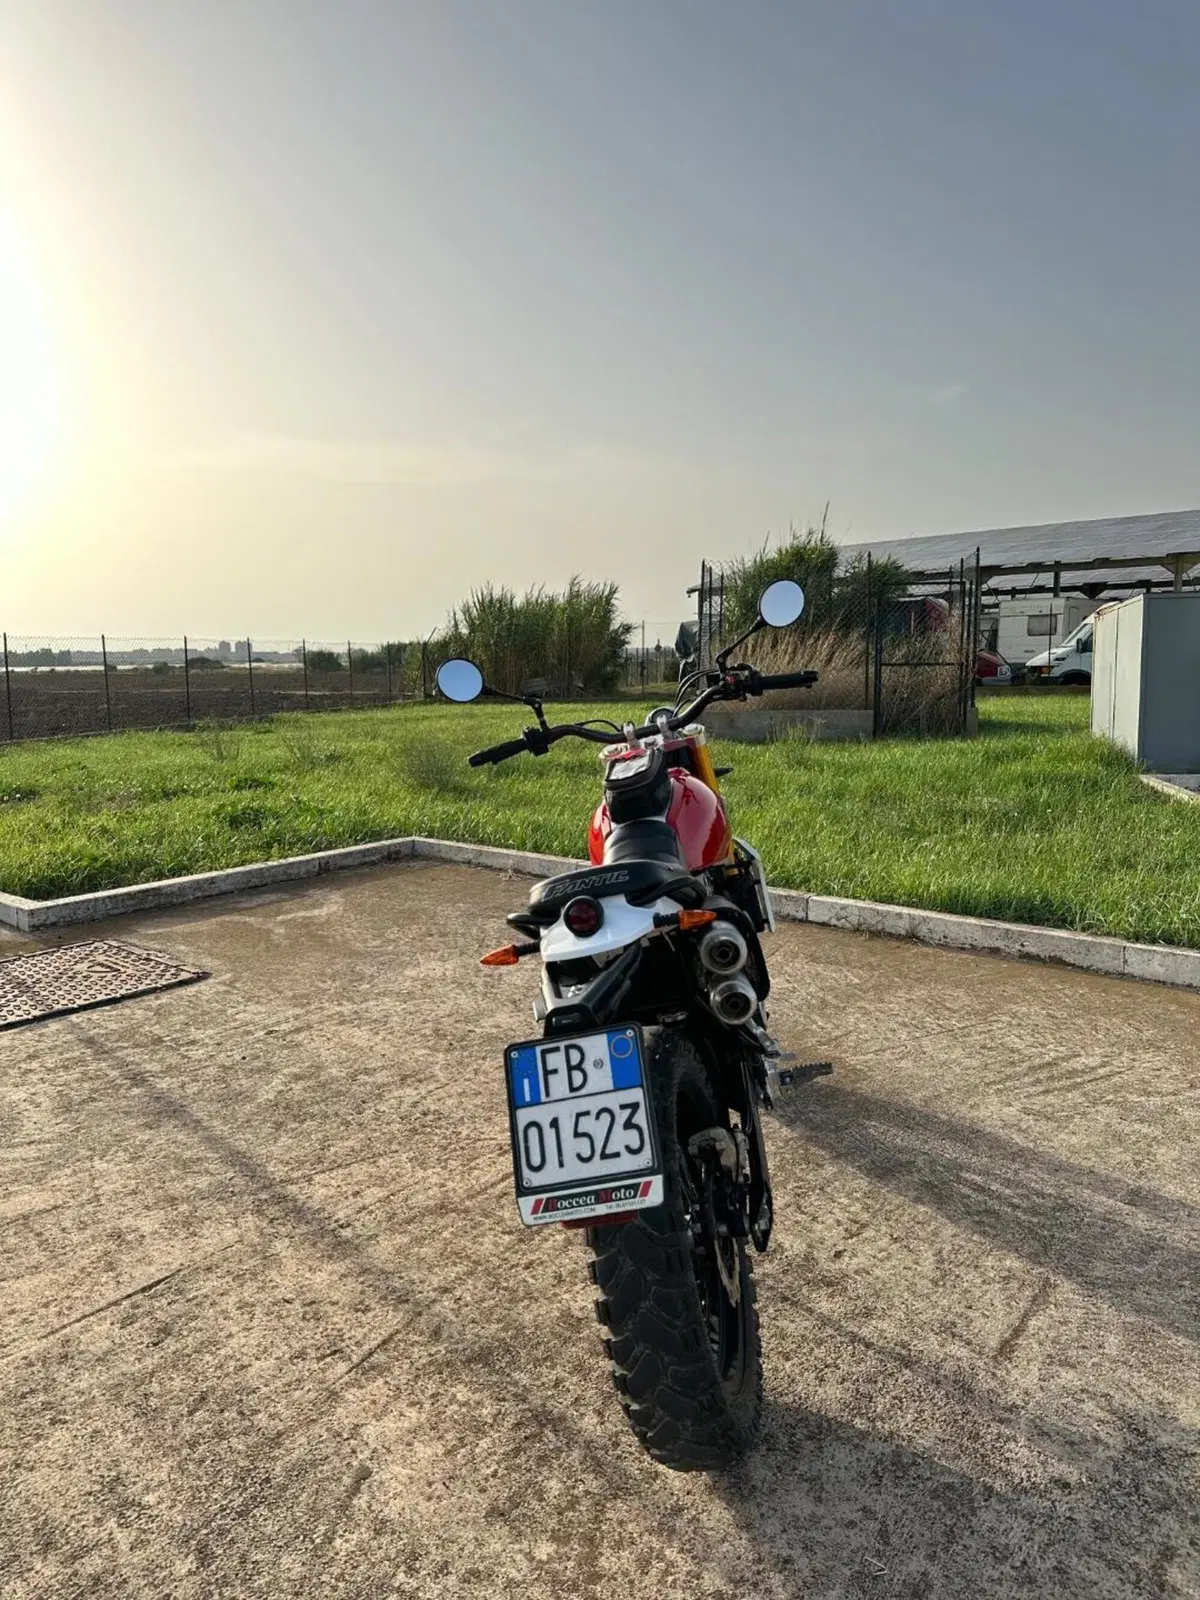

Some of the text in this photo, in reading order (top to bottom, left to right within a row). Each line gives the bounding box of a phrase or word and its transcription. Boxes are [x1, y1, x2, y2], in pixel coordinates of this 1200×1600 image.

[543, 870, 629, 900] FANTIC
[540, 1043, 588, 1098] FB
[522, 1102, 645, 1173] 01523
